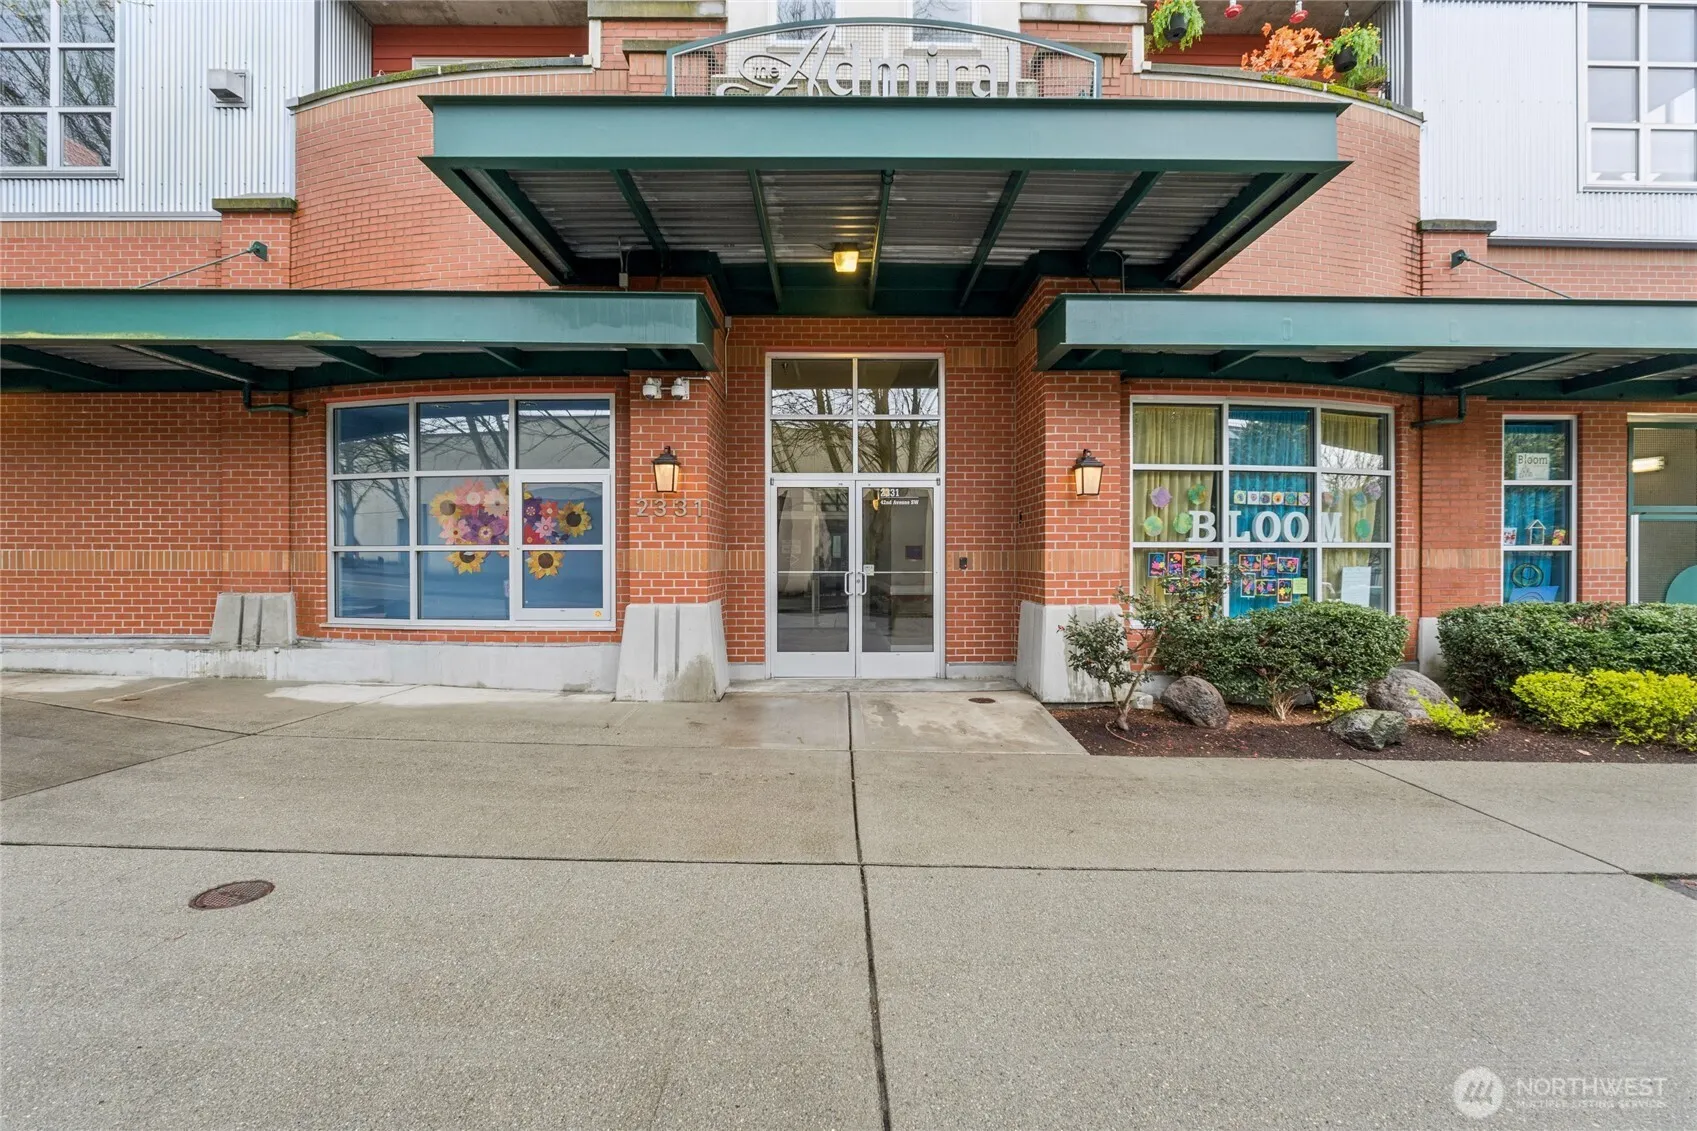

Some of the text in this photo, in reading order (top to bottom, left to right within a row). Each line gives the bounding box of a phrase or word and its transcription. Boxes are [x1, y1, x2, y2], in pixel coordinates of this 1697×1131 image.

[716, 24, 1018, 98] Admiral
[1517, 454, 1549, 465] Bloom
[880, 488, 900, 497] 2331
[636, 498, 703, 518] 2331
[1187, 510, 1344, 543] BLOOM
